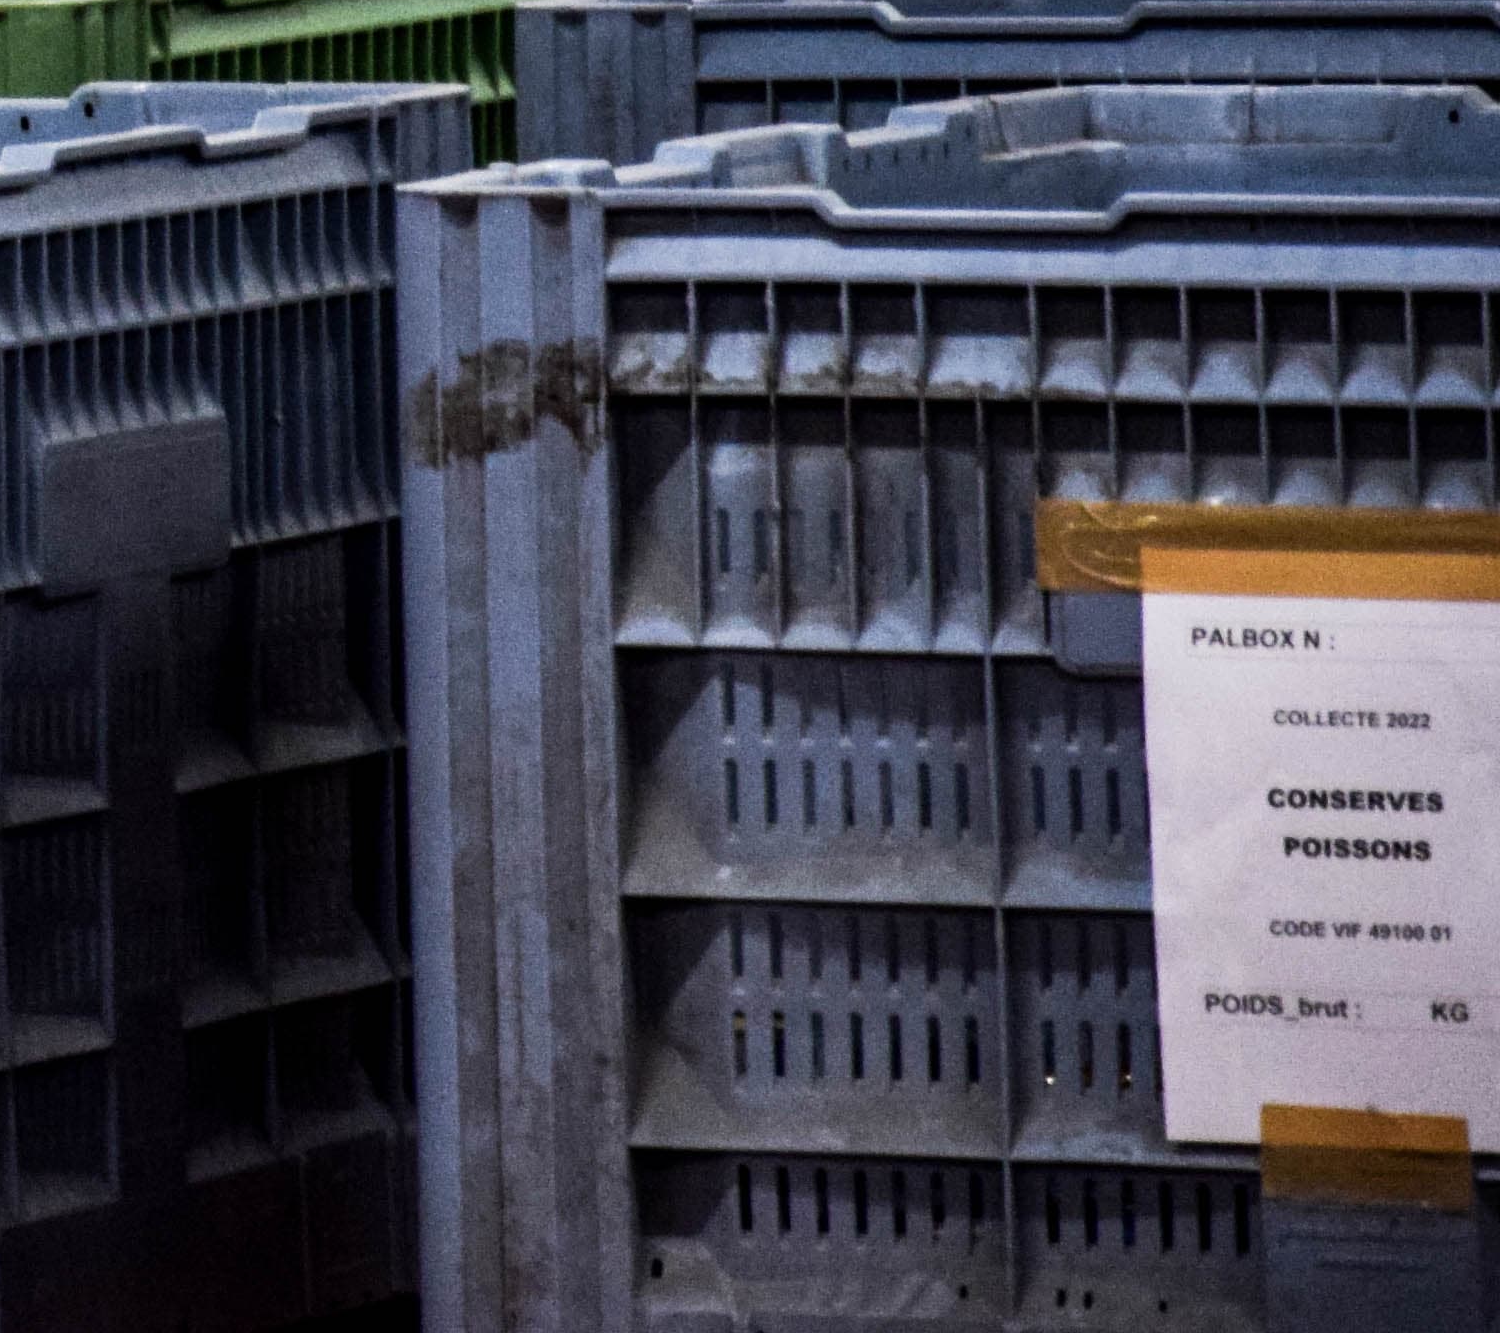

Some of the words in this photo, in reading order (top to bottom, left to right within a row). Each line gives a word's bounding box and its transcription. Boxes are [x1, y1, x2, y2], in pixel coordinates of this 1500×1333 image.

[1190, 626, 1296, 650] PALBOX
[1302, 630, 1321, 650] N
[1272, 709, 1381, 729] COLLECTE
[1386, 711, 1432, 730] 2022
[1267, 787, 1445, 813] CONSERVES
[1283, 836, 1432, 863] POISSONS
[1268, 919, 1326, 938] CODE
[1331, 921, 1362, 939] VIF
[1204, 992, 1349, 1023] POIDS_brut
[1431, 998, 1470, 1023] KG
